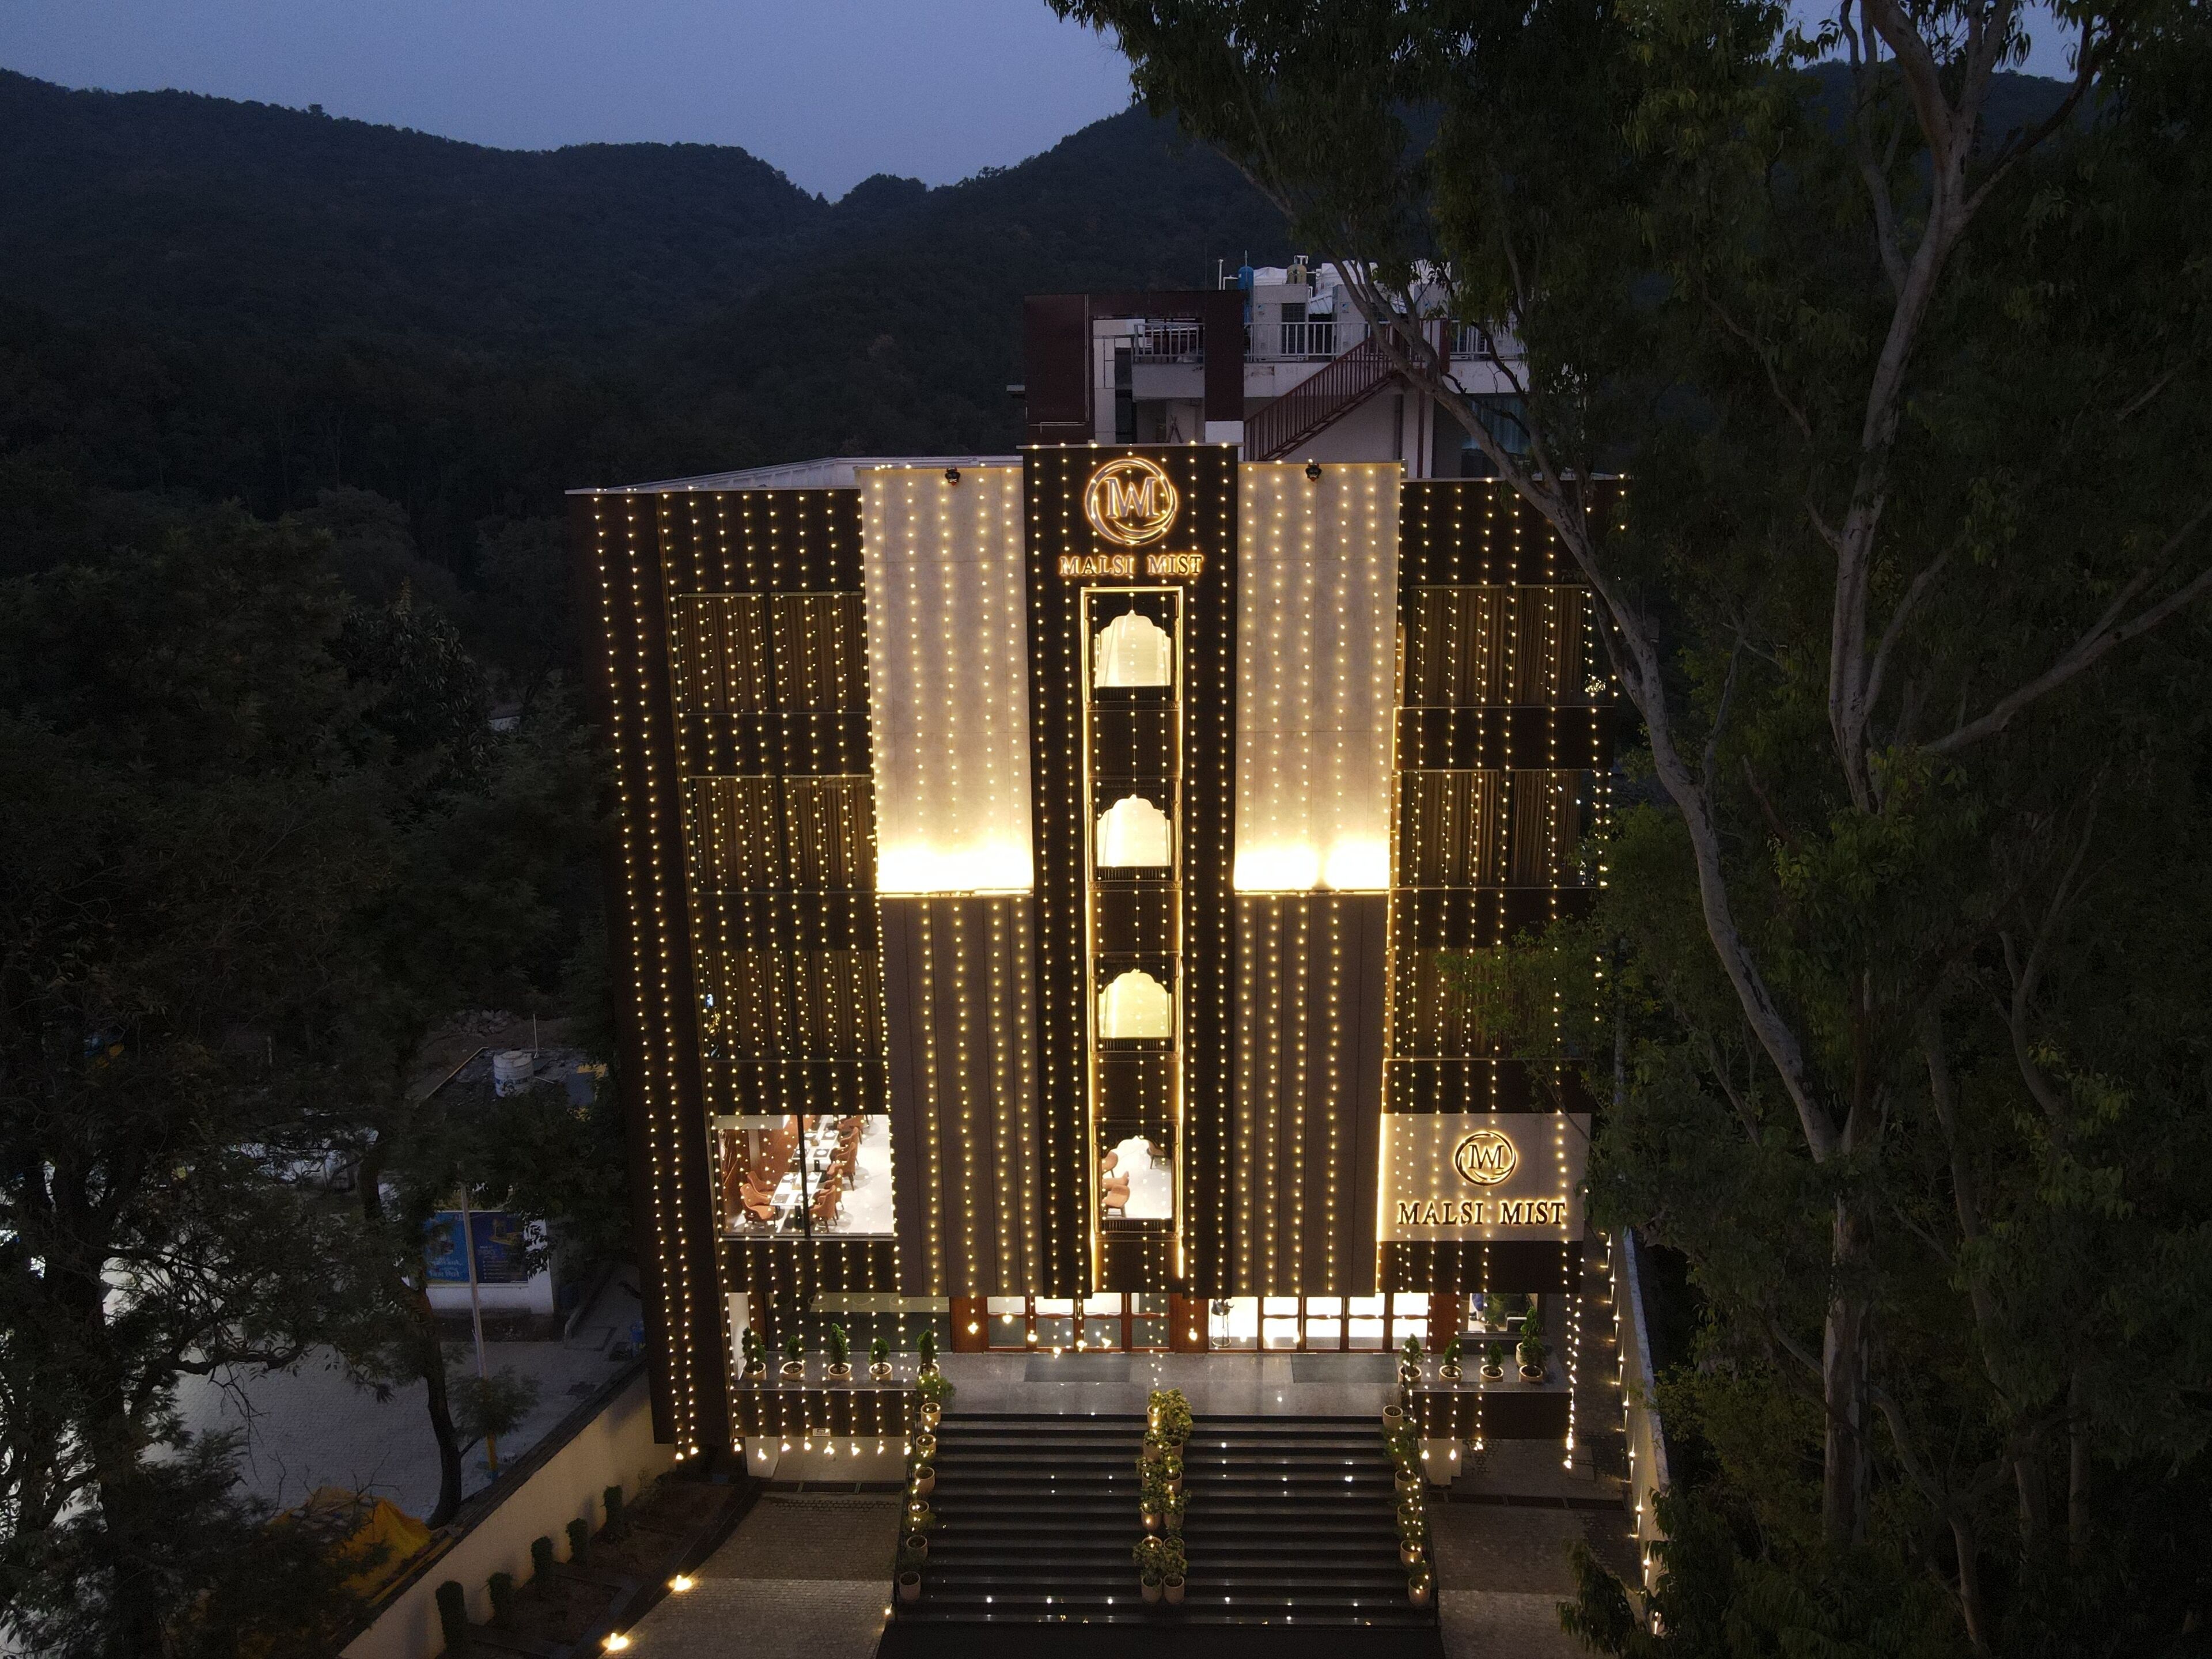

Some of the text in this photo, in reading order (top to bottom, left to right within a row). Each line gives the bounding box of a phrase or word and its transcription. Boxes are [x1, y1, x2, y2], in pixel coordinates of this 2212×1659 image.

[1059, 555, 1203, 575] MALSI MIST
[1398, 1201, 1566, 1225] MALSI MIST
